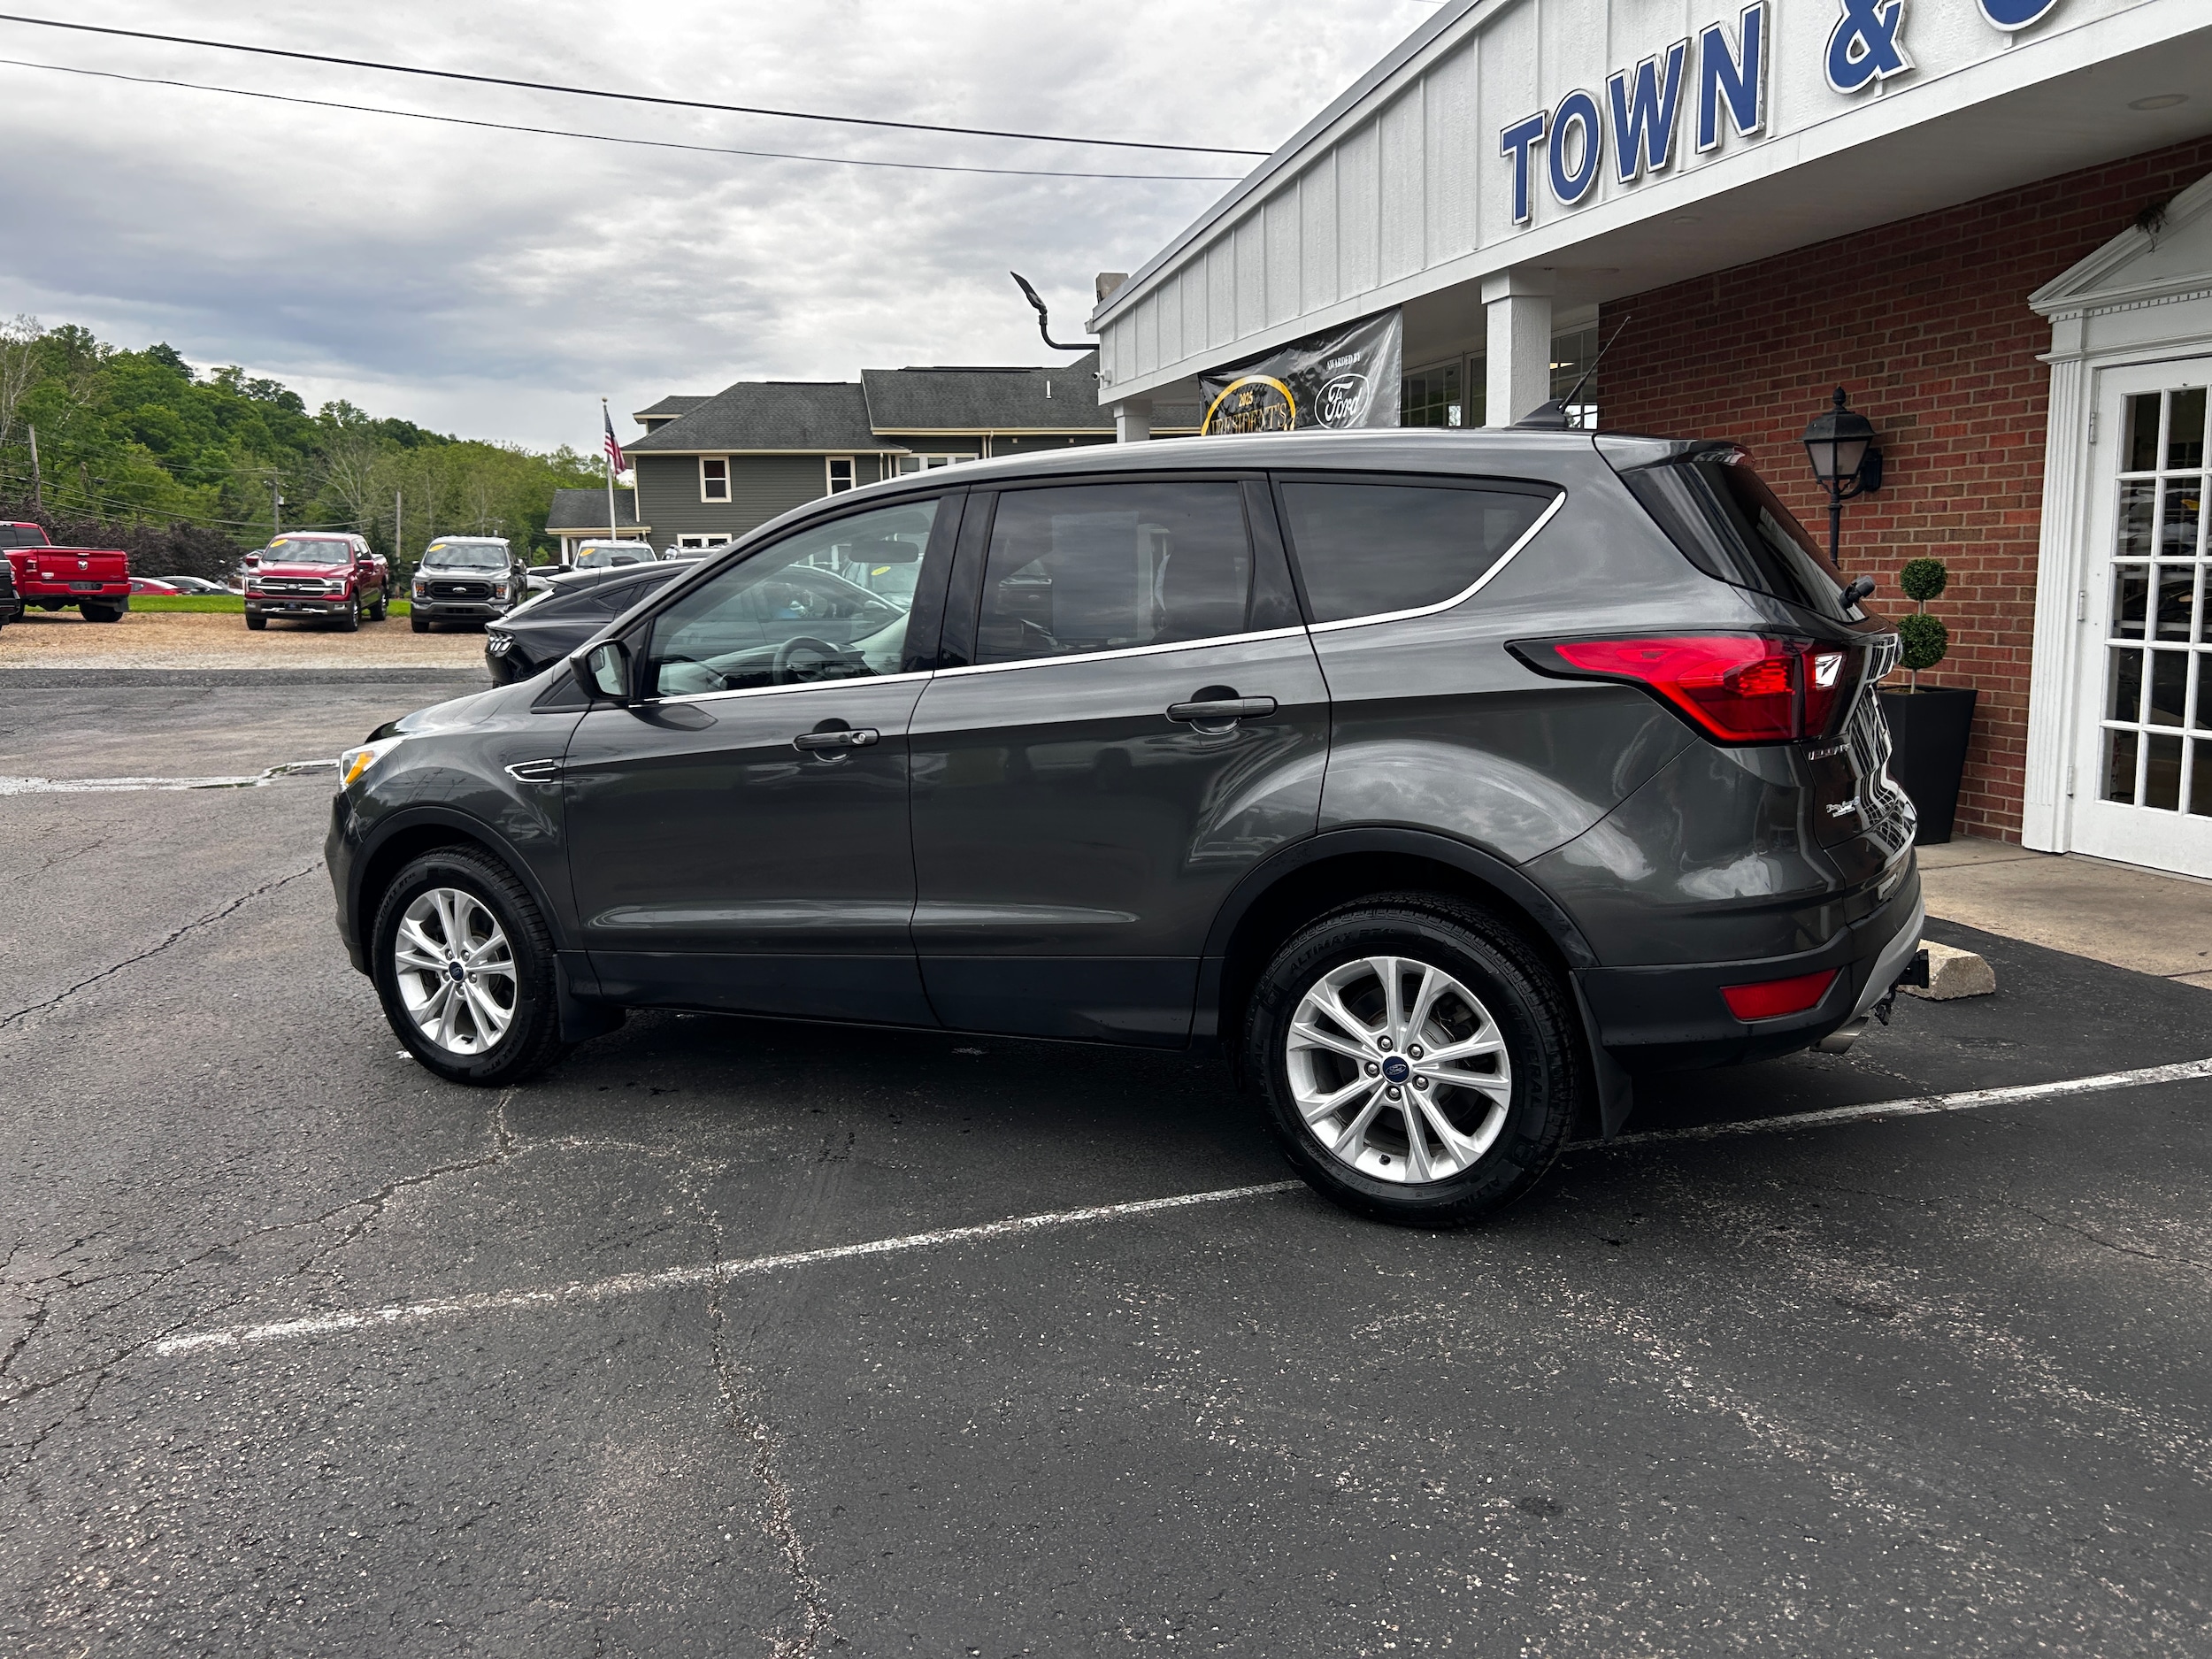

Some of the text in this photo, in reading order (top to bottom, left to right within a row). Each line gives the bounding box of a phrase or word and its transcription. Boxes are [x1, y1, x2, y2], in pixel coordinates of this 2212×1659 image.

[1500, 0, 1916, 226] TOWN &
[1238, 390, 1254, 407] 2025
[1325, 380, 1363, 421] Ford
